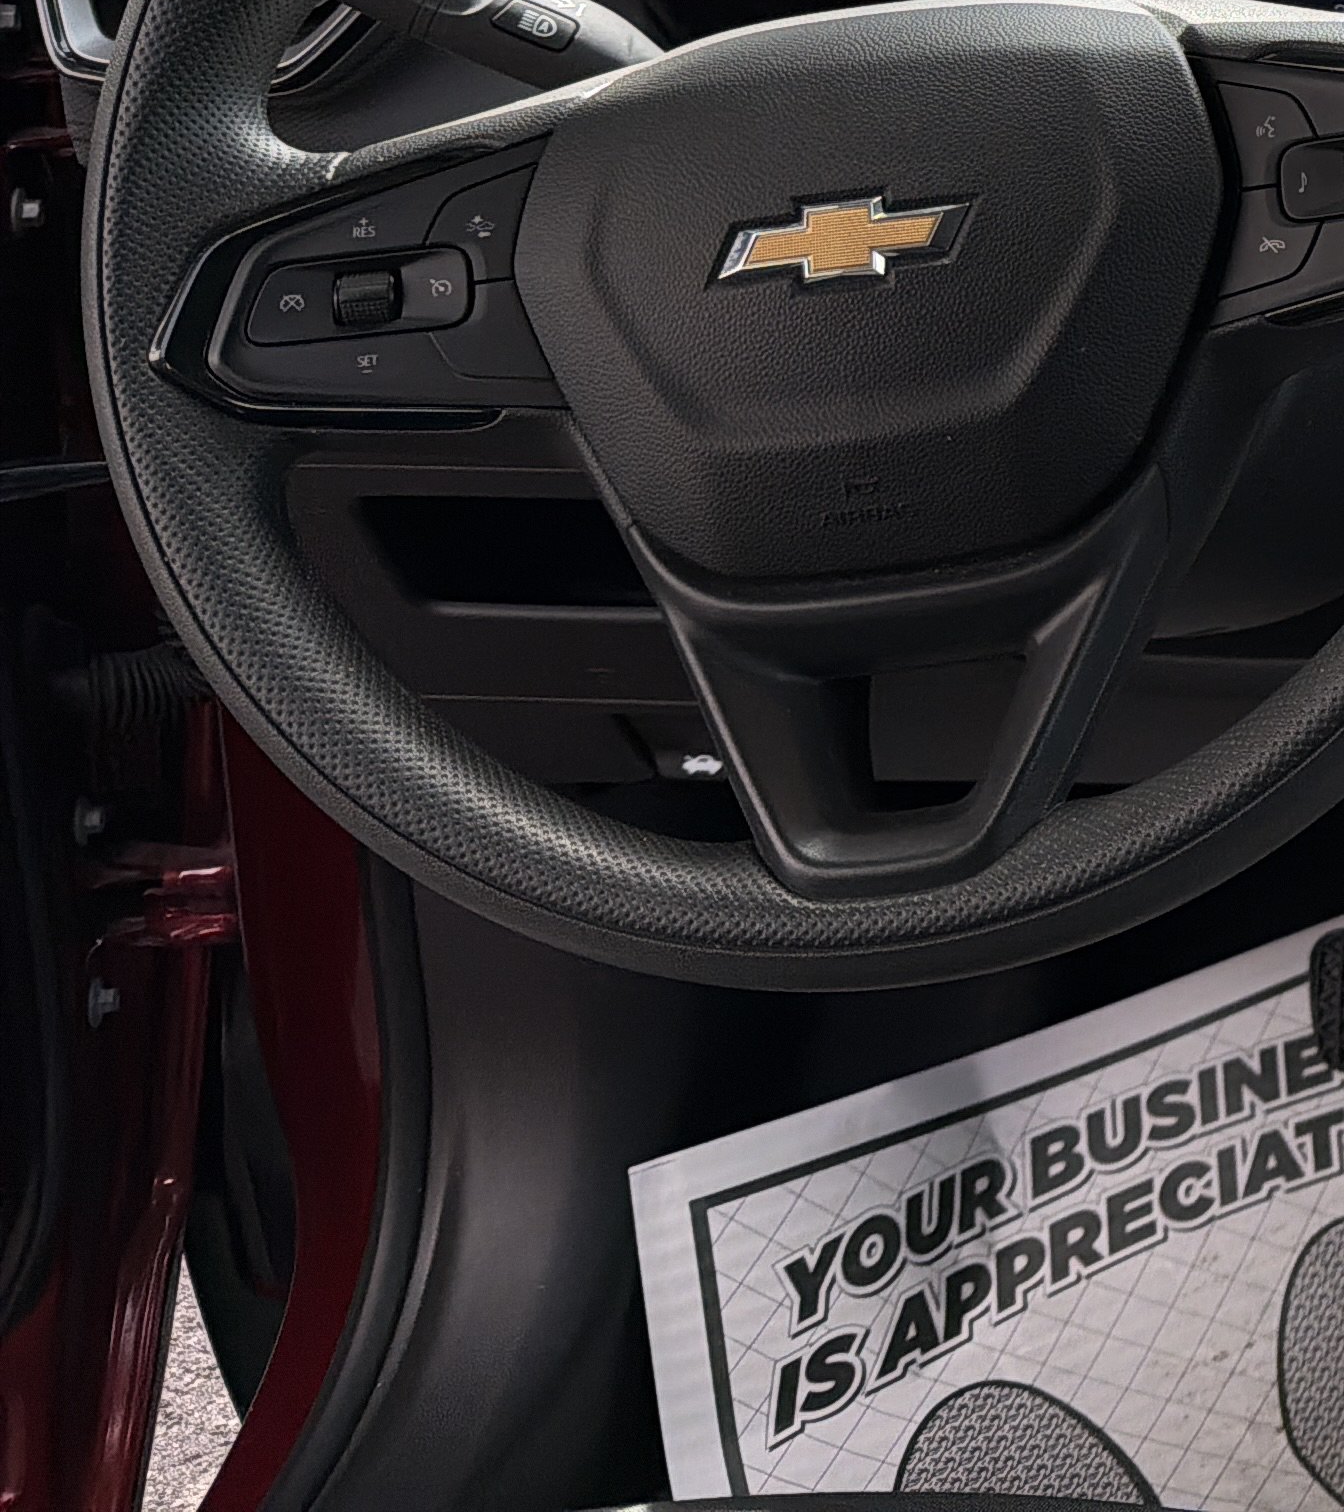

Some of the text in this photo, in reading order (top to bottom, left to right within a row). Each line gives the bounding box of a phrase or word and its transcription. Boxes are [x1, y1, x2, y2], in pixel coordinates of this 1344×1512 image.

[352, 225, 376, 238] RES
[357, 354, 379, 368] SET
[786, 1167, 1012, 1328] YOUR
[769, 1326, 868, 1446] IS
